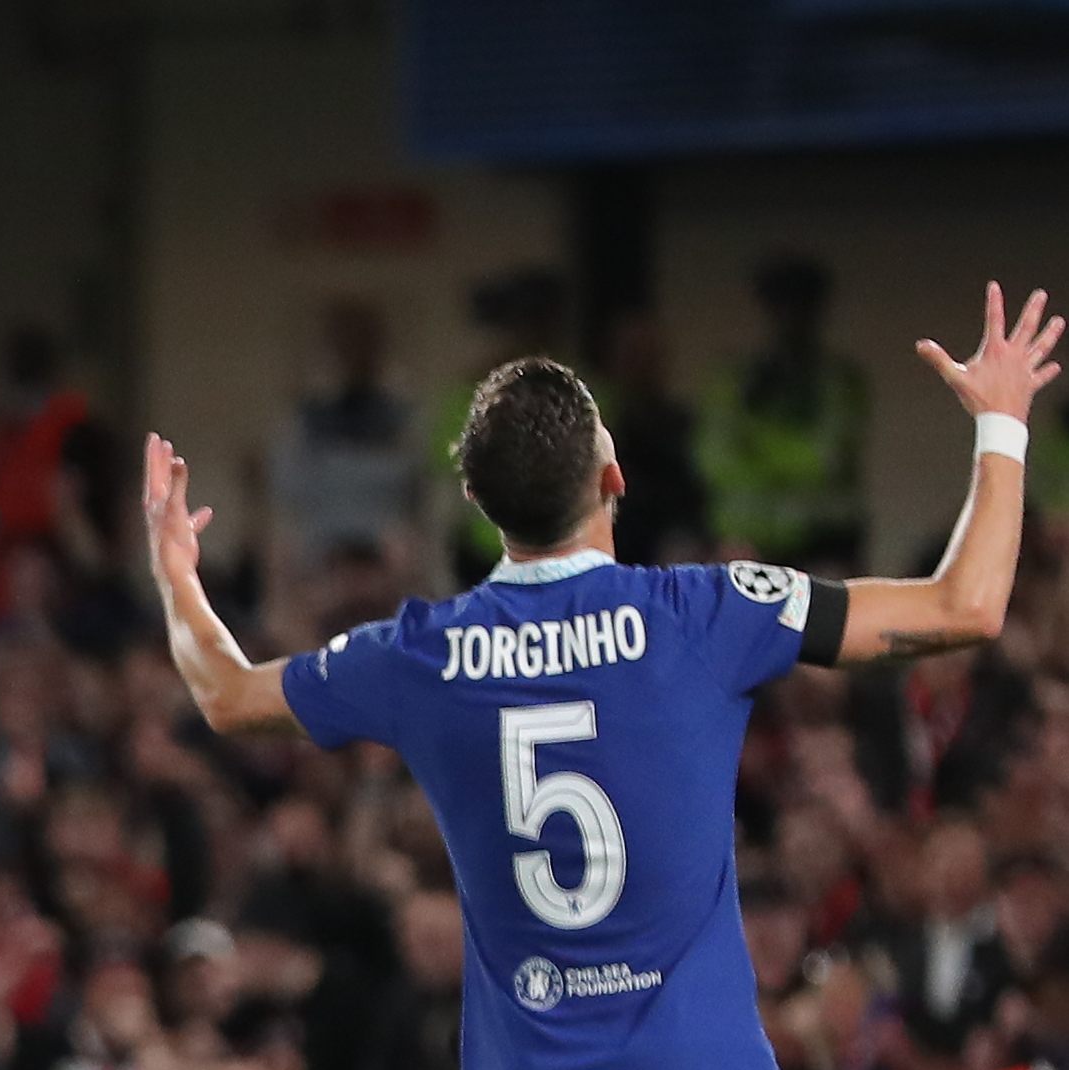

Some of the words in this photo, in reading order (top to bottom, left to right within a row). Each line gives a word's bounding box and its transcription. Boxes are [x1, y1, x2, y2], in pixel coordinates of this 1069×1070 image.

[441, 604, 646, 682] JORGINHO
[499, 700, 627, 930] 5
[566, 969, 663, 998] FOUNDATION
